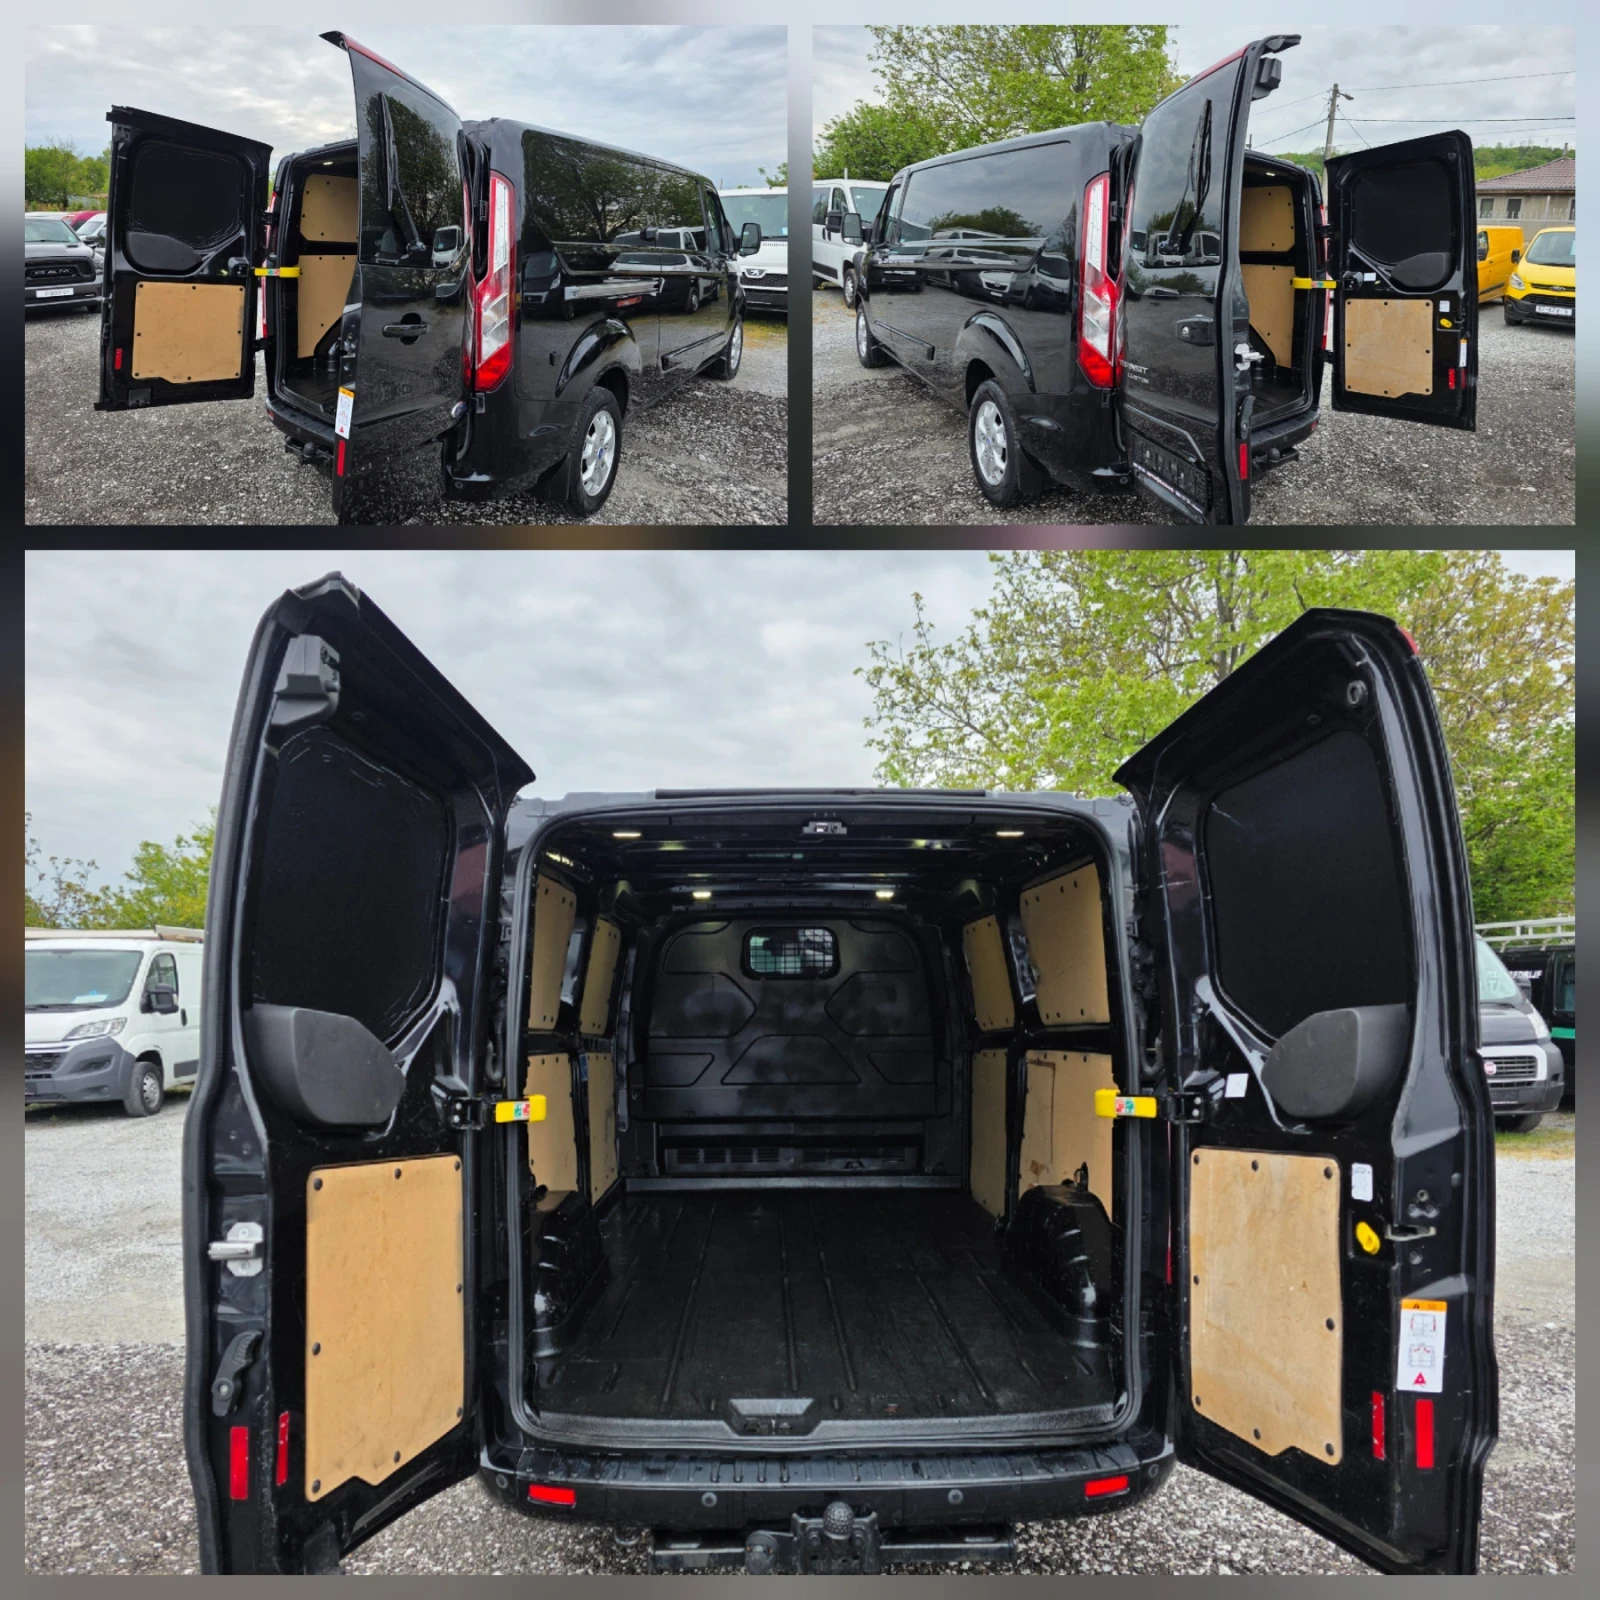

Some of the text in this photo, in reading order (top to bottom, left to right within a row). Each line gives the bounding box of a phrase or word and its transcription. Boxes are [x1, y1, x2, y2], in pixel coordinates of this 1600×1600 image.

[34, 268, 70, 276] RAM
[1119, 359, 1150, 375] TRANSIT
[1127, 372, 1150, 385] CUSTOM
